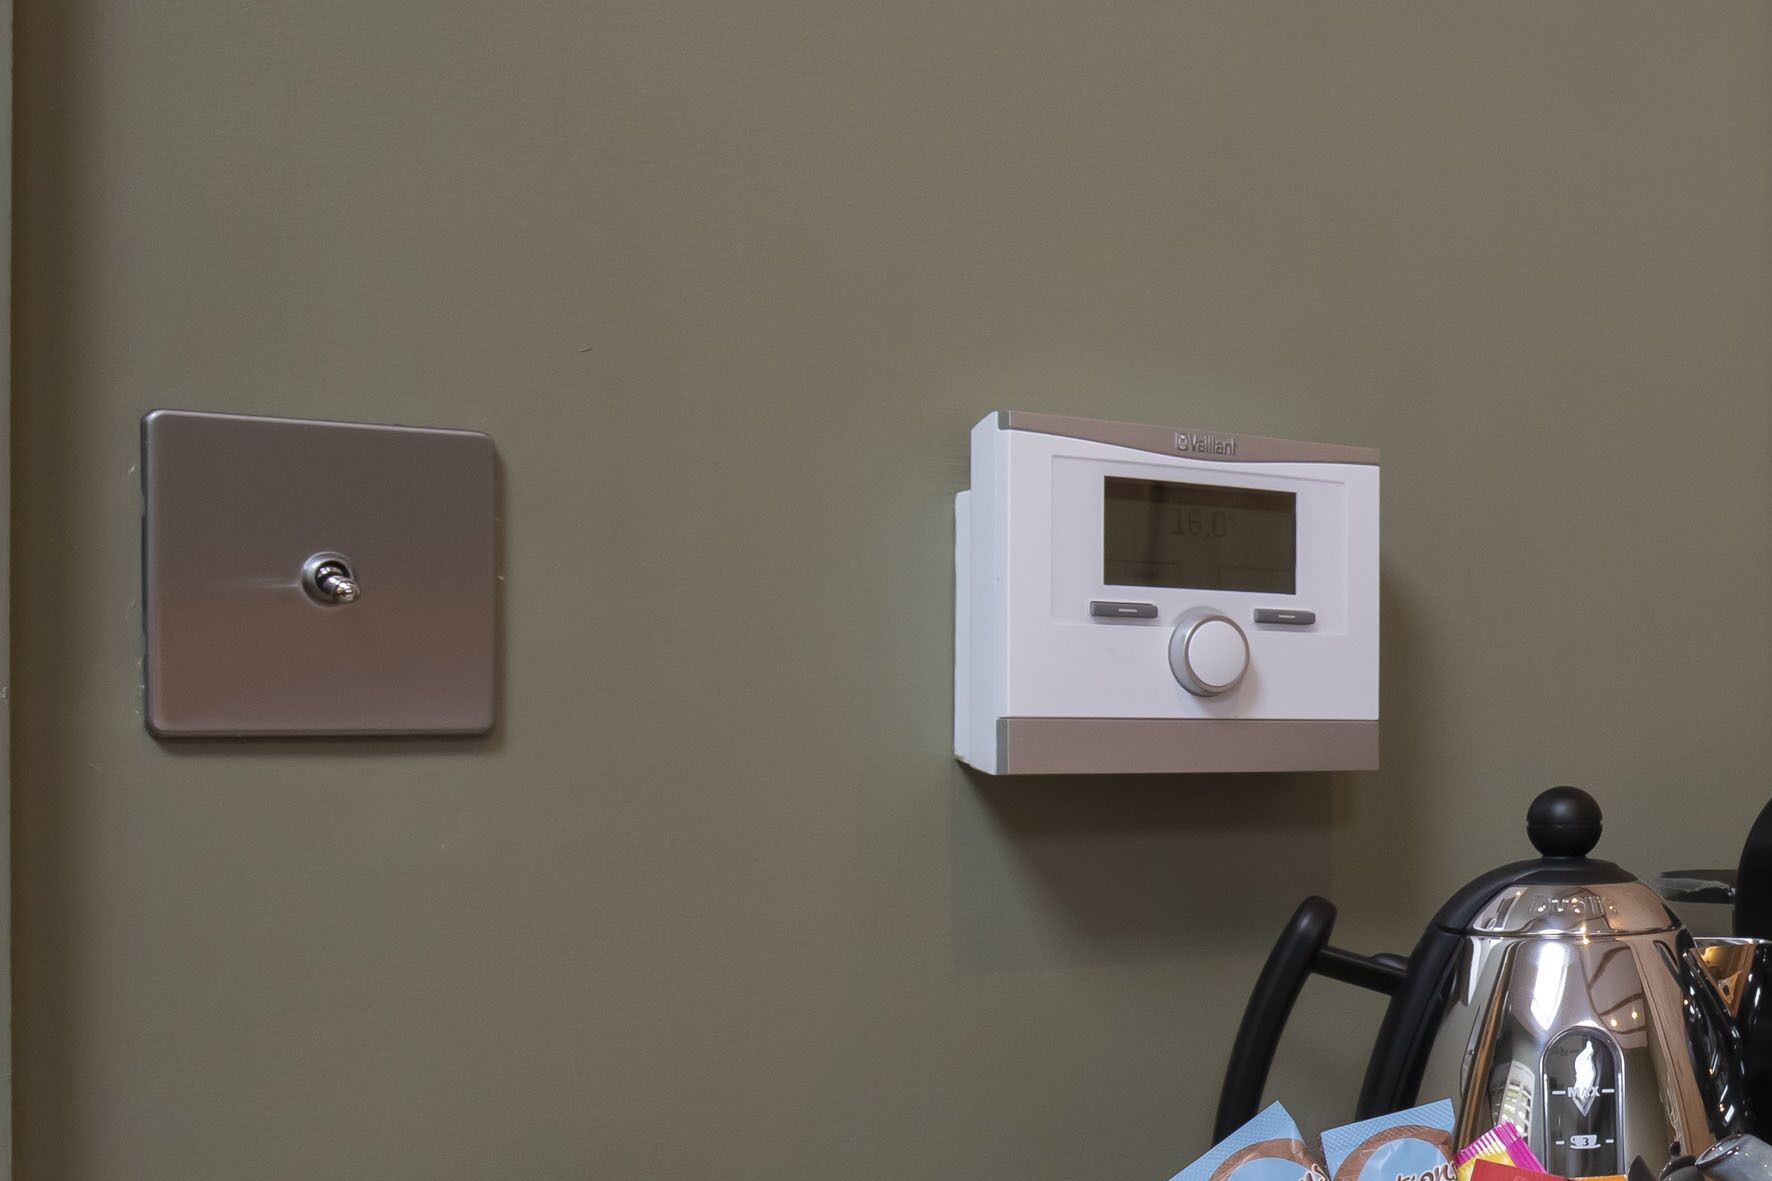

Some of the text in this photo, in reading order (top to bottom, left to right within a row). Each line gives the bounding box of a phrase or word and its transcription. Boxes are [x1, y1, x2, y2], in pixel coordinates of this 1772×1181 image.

[1189, 433, 1236, 456] Vaillant
[1567, 1086, 1600, 1098] MAX
[1582, 1137, 1590, 1147] 3
